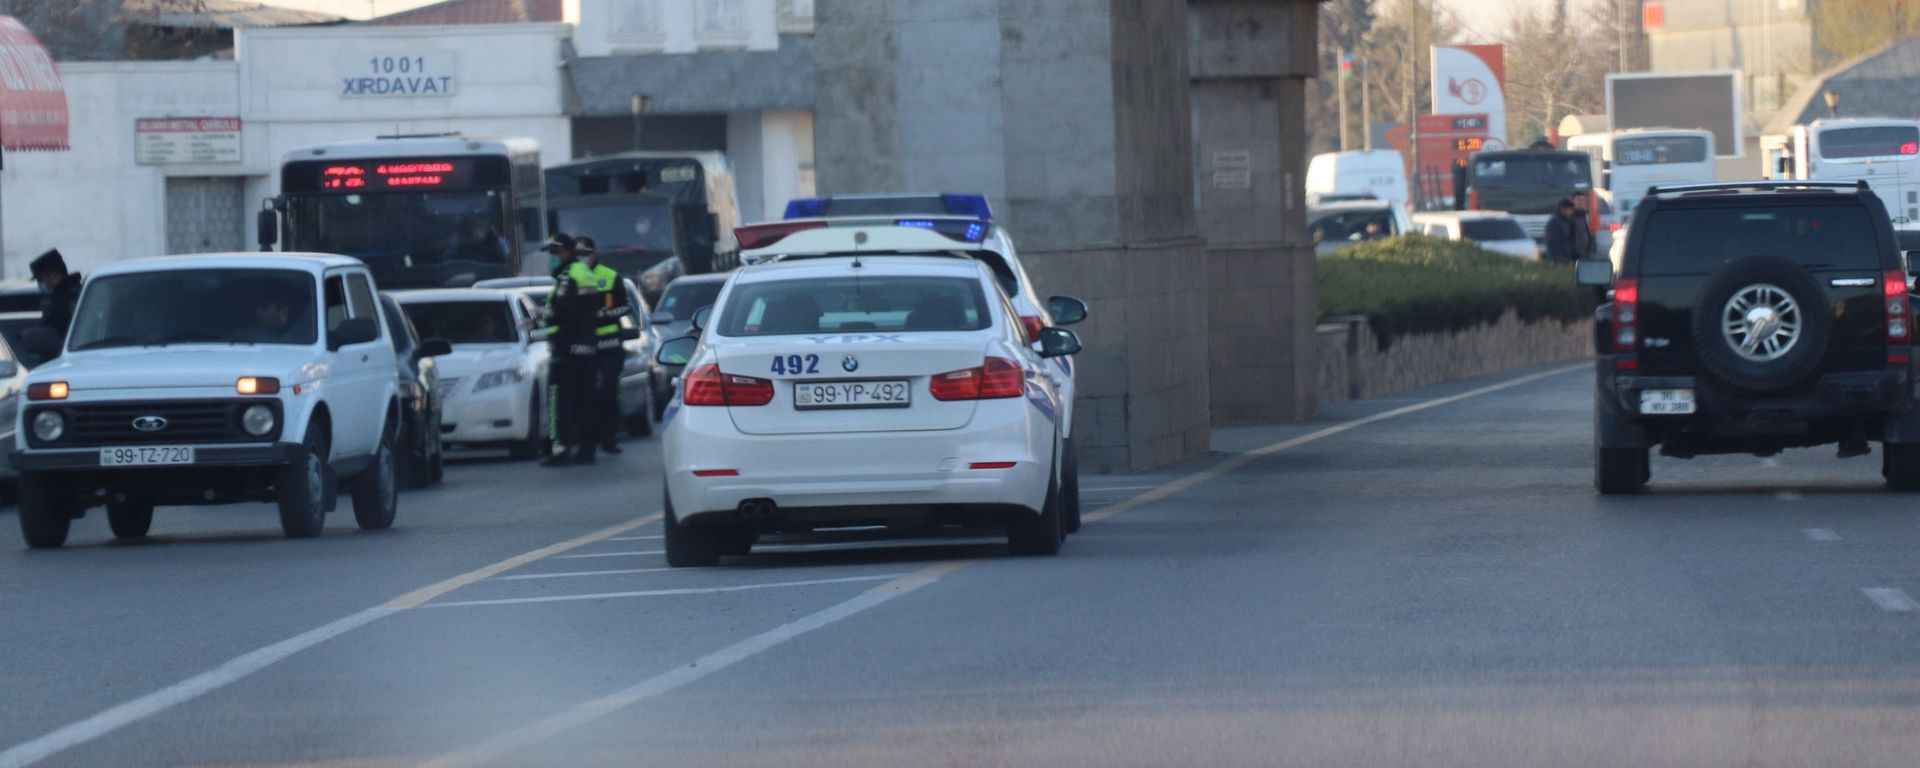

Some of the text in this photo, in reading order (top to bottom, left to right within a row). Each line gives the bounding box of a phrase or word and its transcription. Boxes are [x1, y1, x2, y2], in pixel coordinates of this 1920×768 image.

[370, 56, 423, 74] 1001
[342, 77, 451, 95] XIRDAVAT
[771, 354, 820, 375] 492
[814, 383, 905, 403] 99-YP-492
[115, 446, 190, 464] 99-TZ-720
